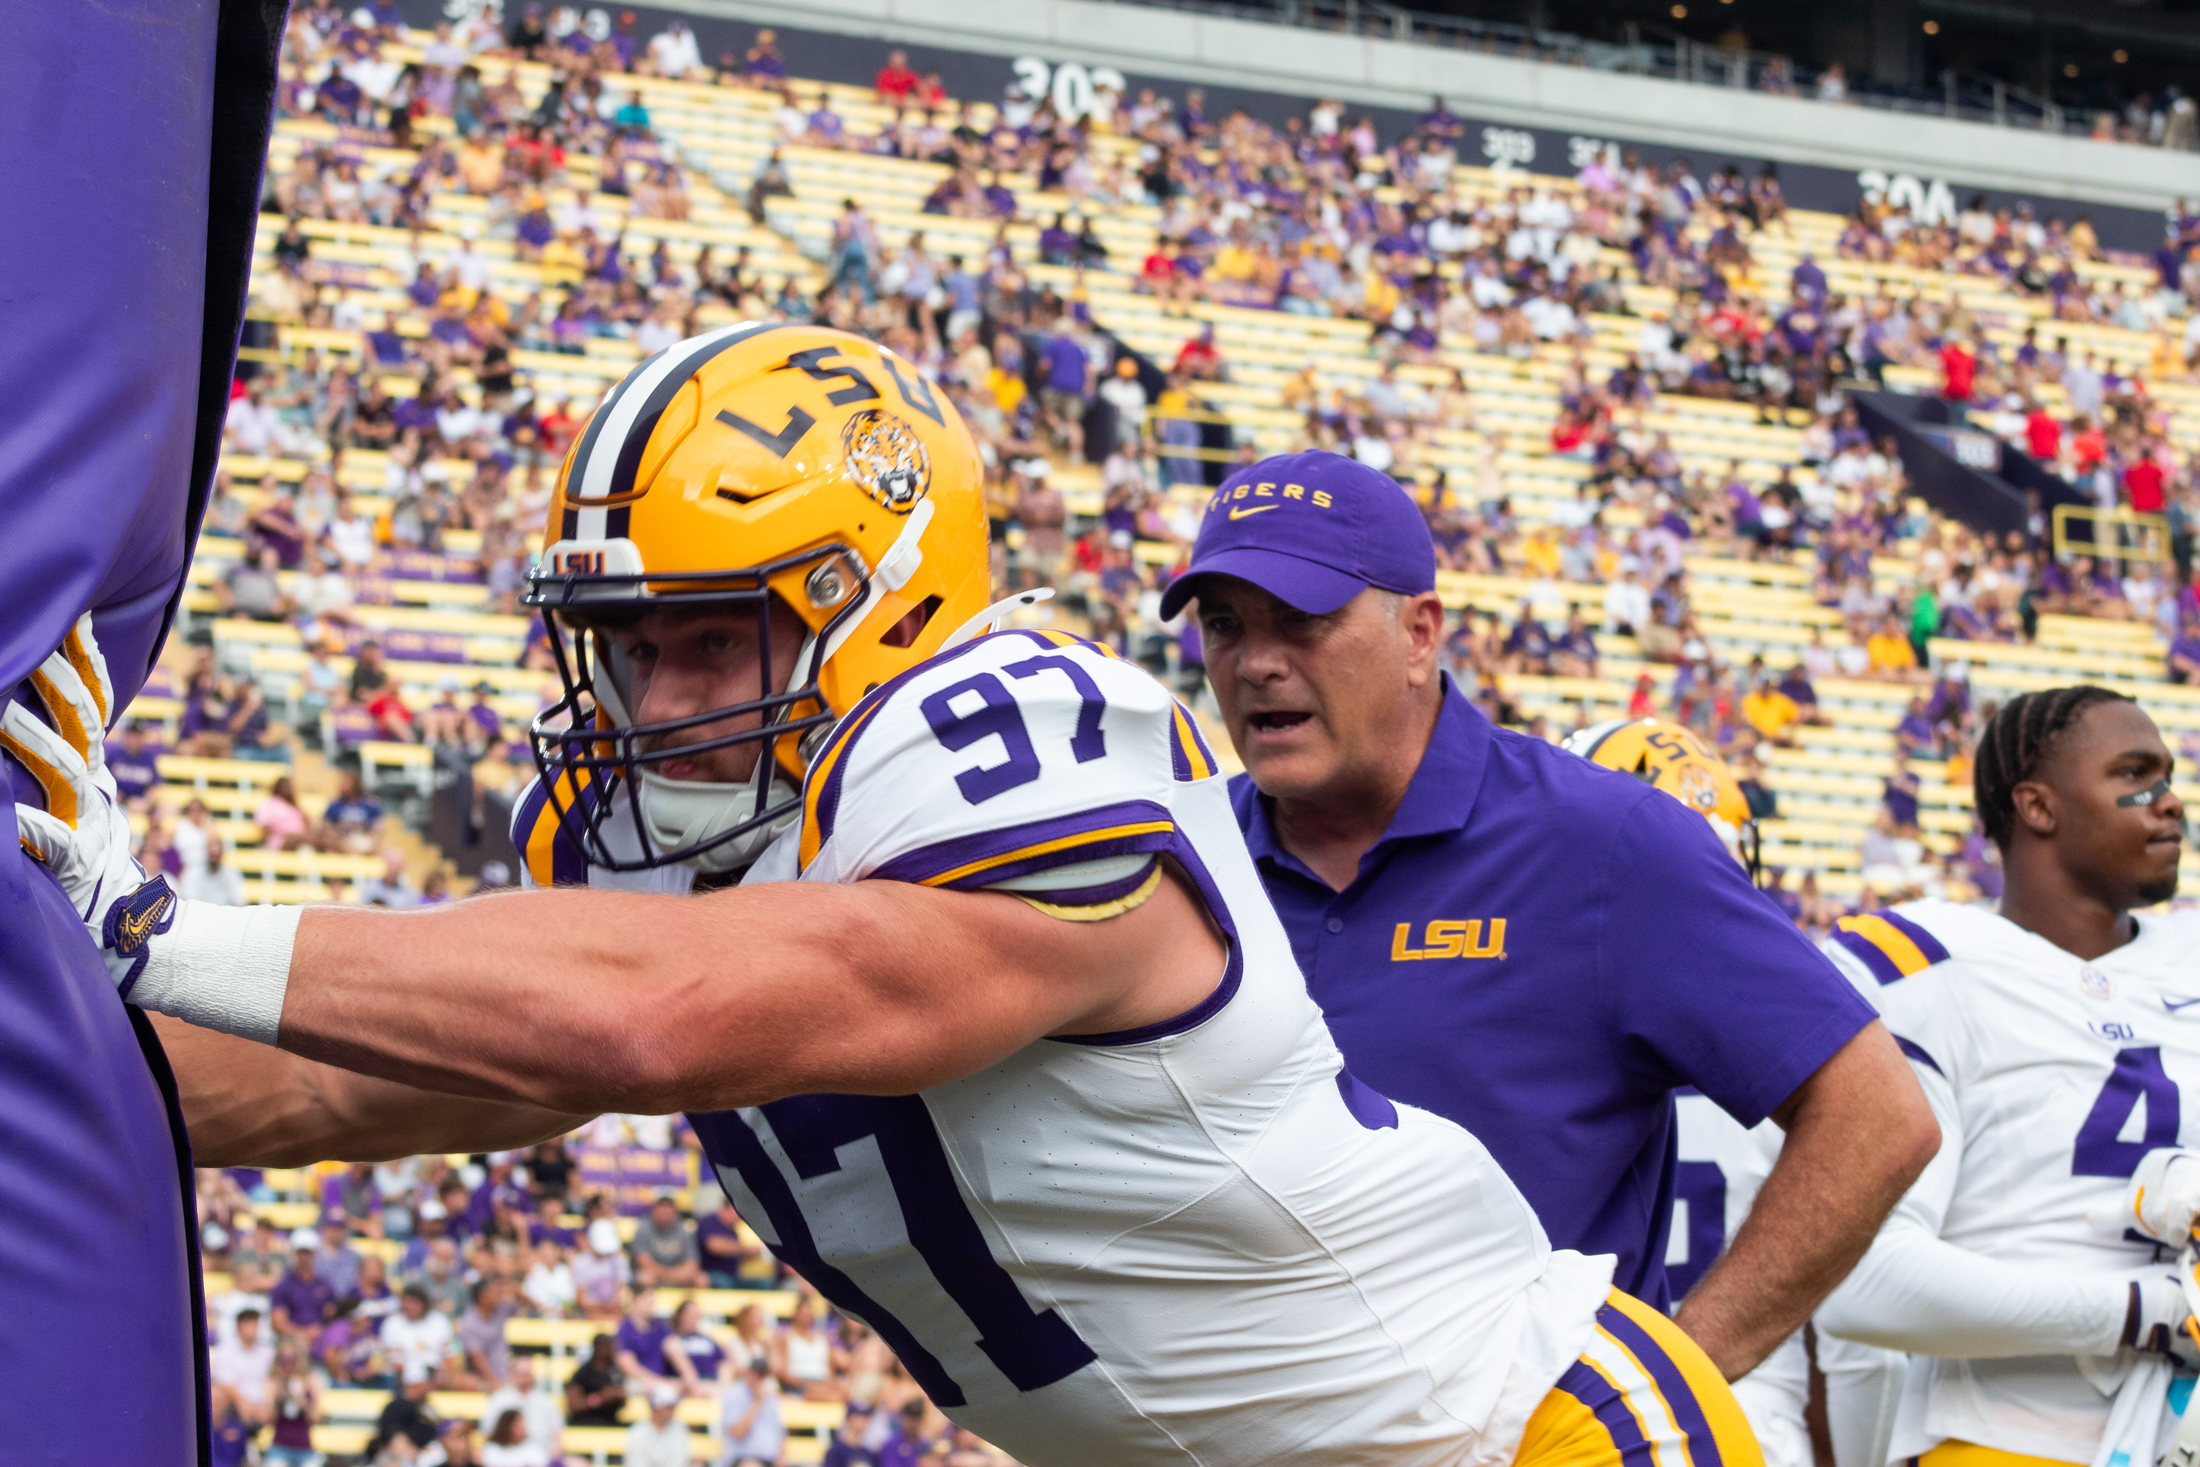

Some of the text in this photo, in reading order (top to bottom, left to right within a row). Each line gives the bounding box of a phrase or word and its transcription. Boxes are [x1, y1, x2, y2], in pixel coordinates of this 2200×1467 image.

[715, 345, 946, 459] LSU
[1210, 482, 1333, 513] TIGERS
[919, 655, 1107, 806] 97
[1391, 918, 1506, 961] LSU
[2087, 1021, 2134, 1041] LSU
